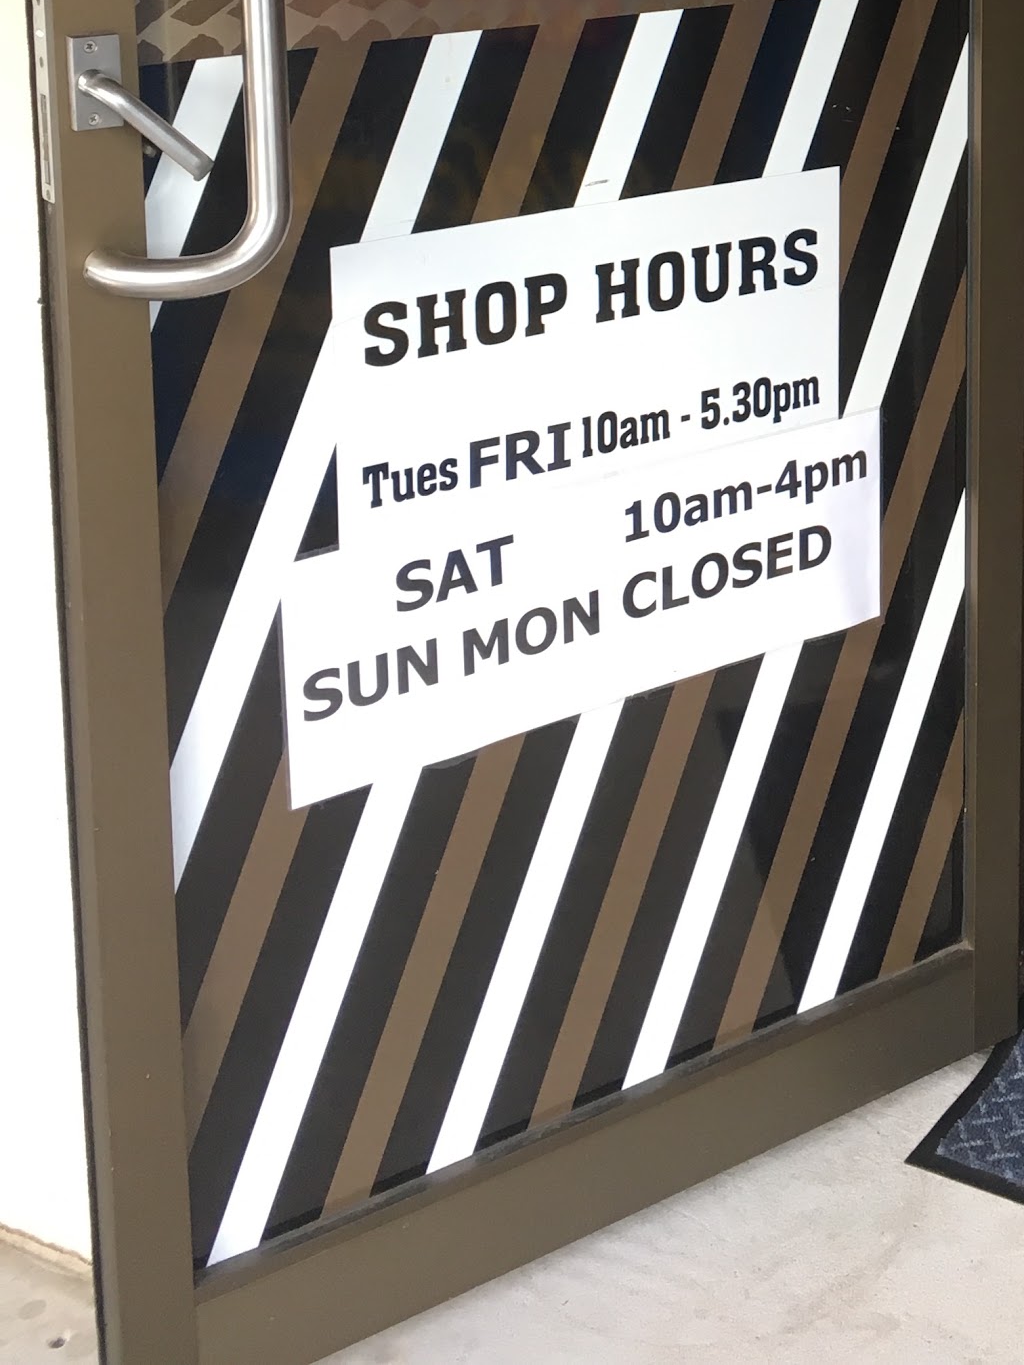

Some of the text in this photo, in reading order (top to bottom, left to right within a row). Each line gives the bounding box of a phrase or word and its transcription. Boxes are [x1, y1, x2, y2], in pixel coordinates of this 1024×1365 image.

[363, 228, 819, 367] SHOP HOURS
[362, 457, 459, 509] Tues
[469, 422, 574, 488] FRI
[581, 409, 671, 458] 10am
[700, 375, 820, 431] 5.30pm
[395, 448, 868, 612] SAT 10am-4pm
[301, 524, 832, 722] SUN MON CLOSED
